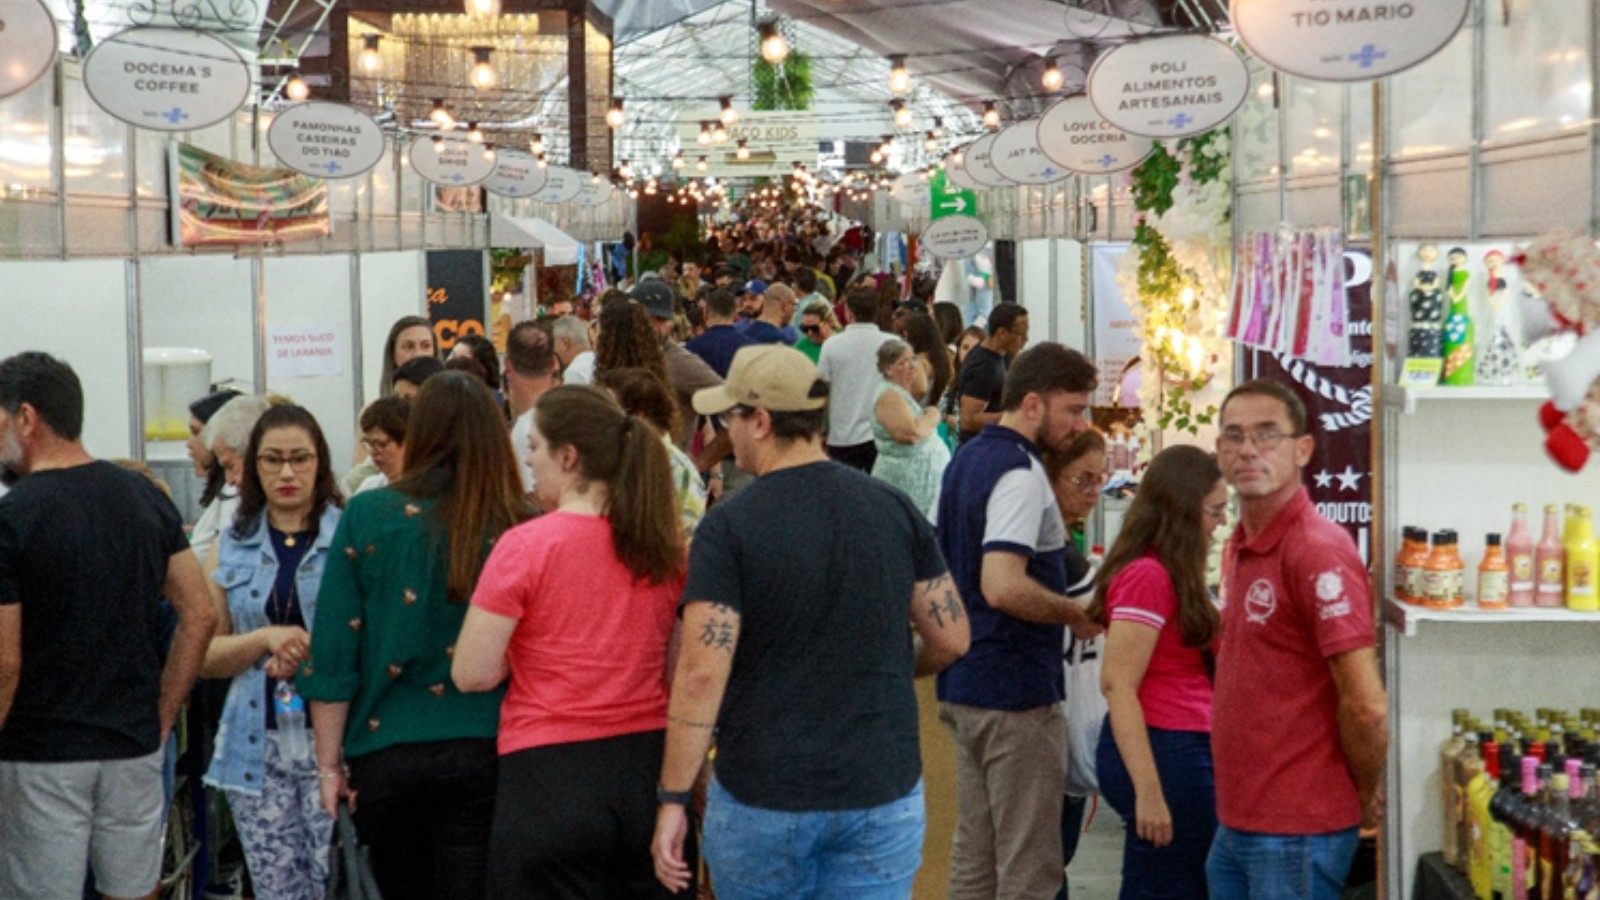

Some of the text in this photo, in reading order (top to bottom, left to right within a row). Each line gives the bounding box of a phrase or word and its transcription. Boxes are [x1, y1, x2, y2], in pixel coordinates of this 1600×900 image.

[1290, 3, 1414, 27] TIO MARIO
[124, 62, 211, 78] DOCEMA'S
[1150, 61, 1186, 74] POLI
[134, 79, 200, 93] COFFEE
[1122, 75, 1217, 93] ALIMENTOS
[1118, 92, 1223, 111] ARTESANAIS
[293, 120, 361, 134] PAMONHAS
[766, 126, 798, 138] KIDS
[1063, 121, 1096, 132] LOVE
[296, 133, 357, 146] CASEIRAS
[1070, 133, 1127, 145] DOCERIA
[302, 146, 320, 155] DO
[308, 332, 334, 342] SUCO
